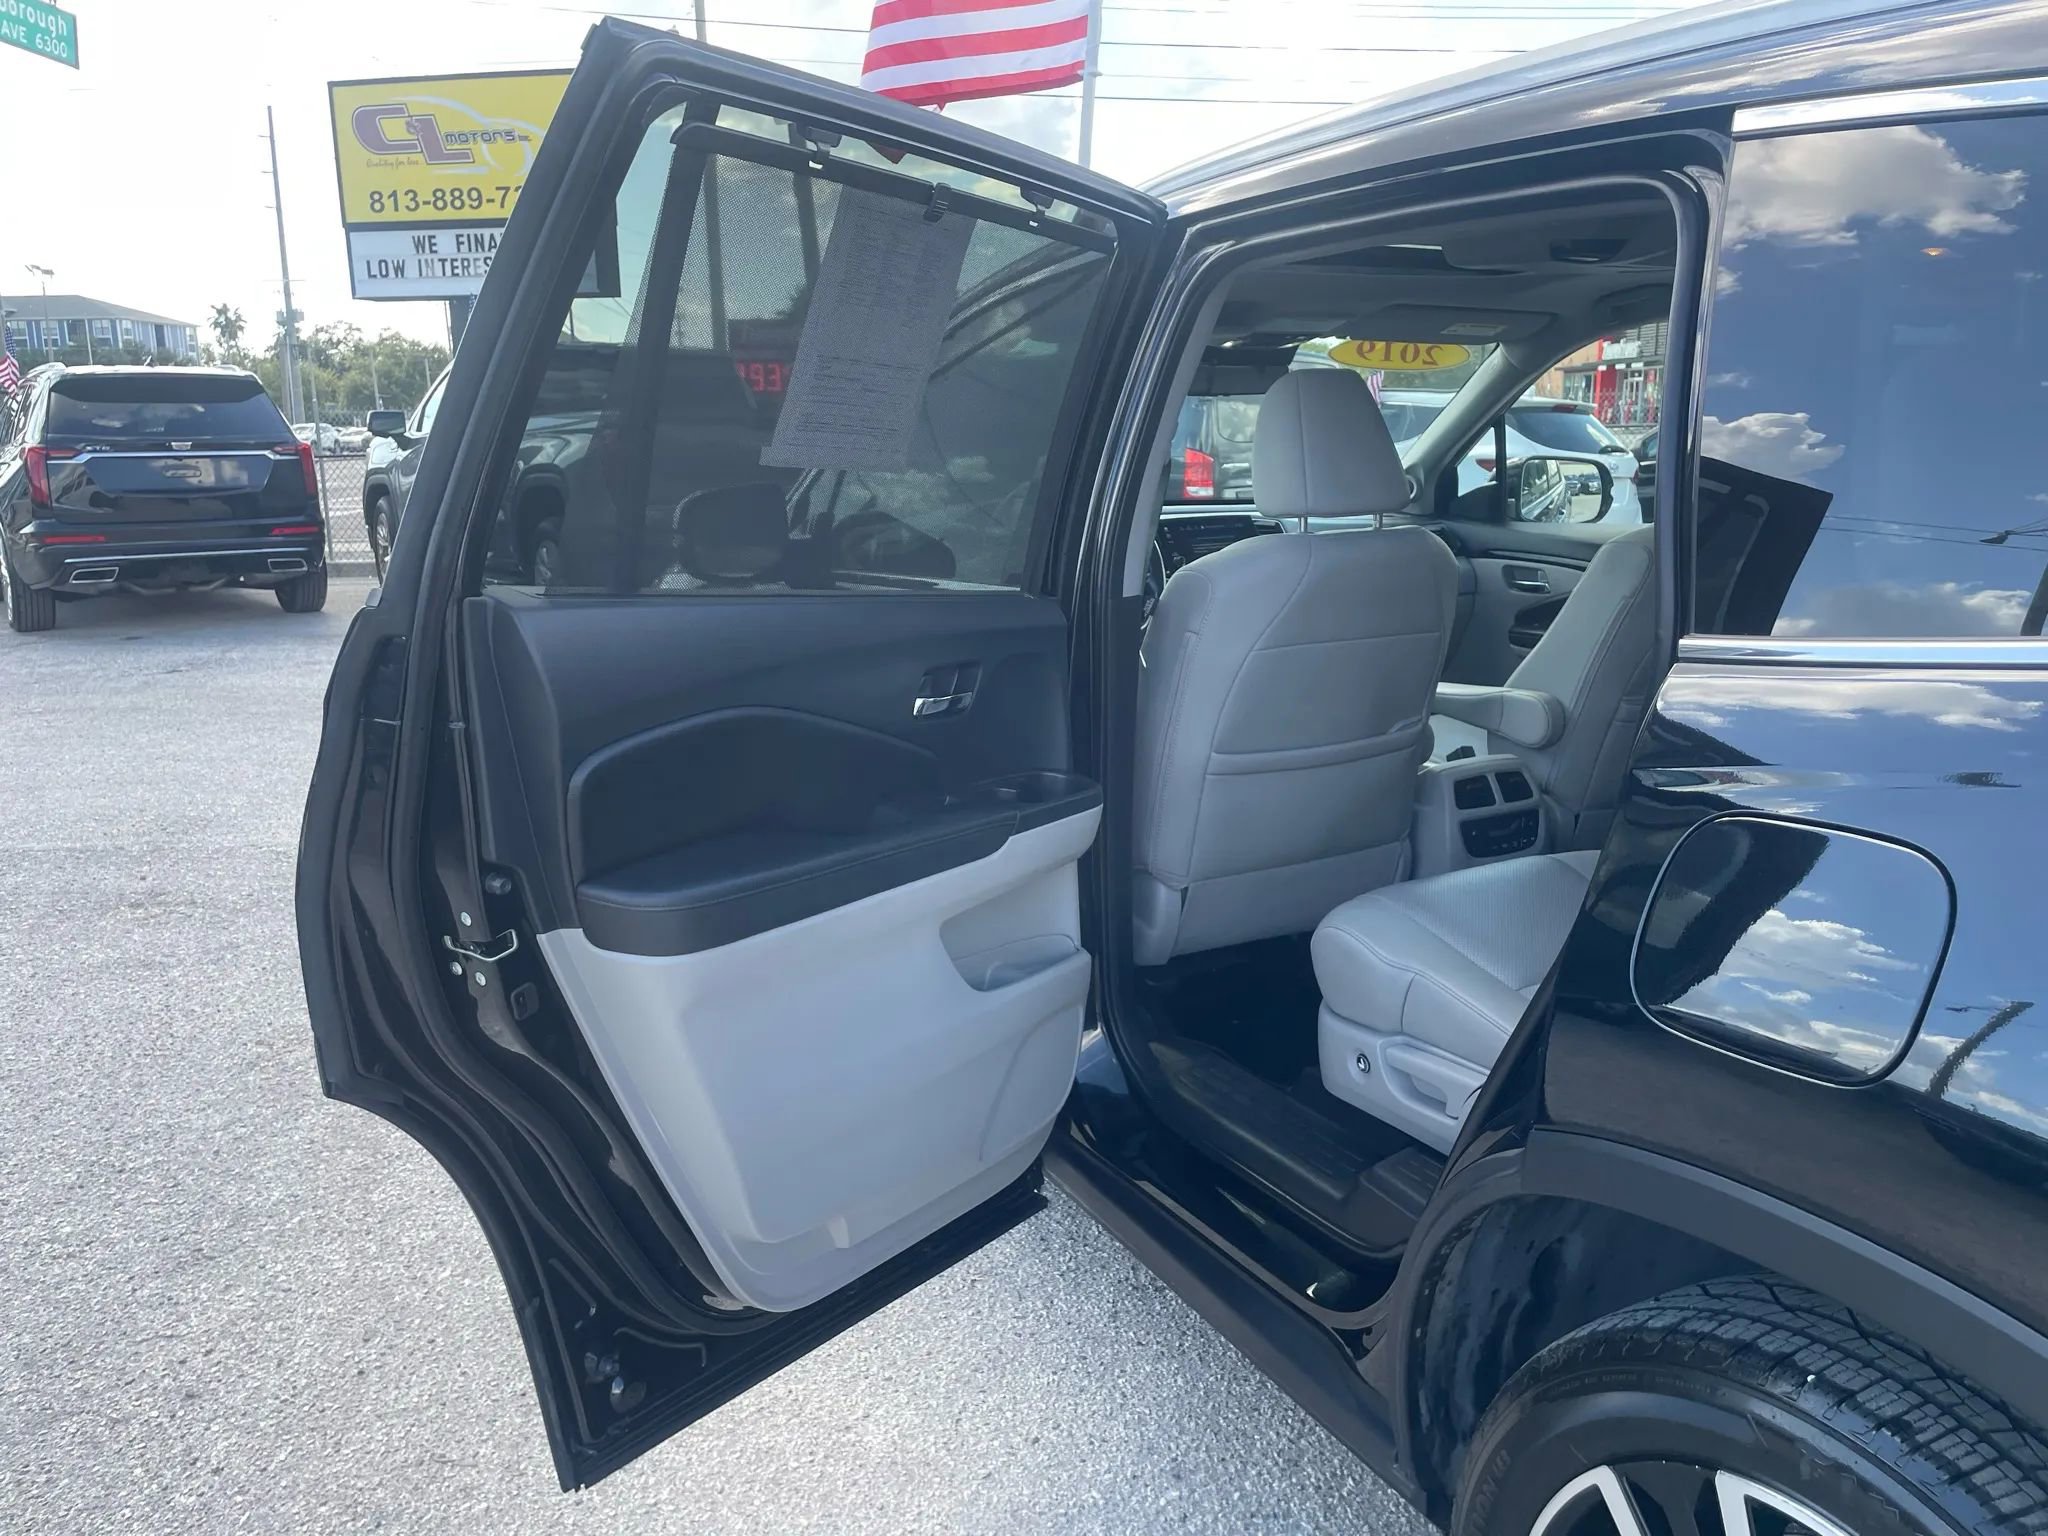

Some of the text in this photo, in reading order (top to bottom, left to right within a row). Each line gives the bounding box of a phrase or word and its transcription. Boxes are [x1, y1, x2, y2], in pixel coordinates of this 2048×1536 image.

[1, 20, 67, 57] AVE 6300
[412, 231, 503, 254] WE FINA
[366, 259, 405, 279] LOW
